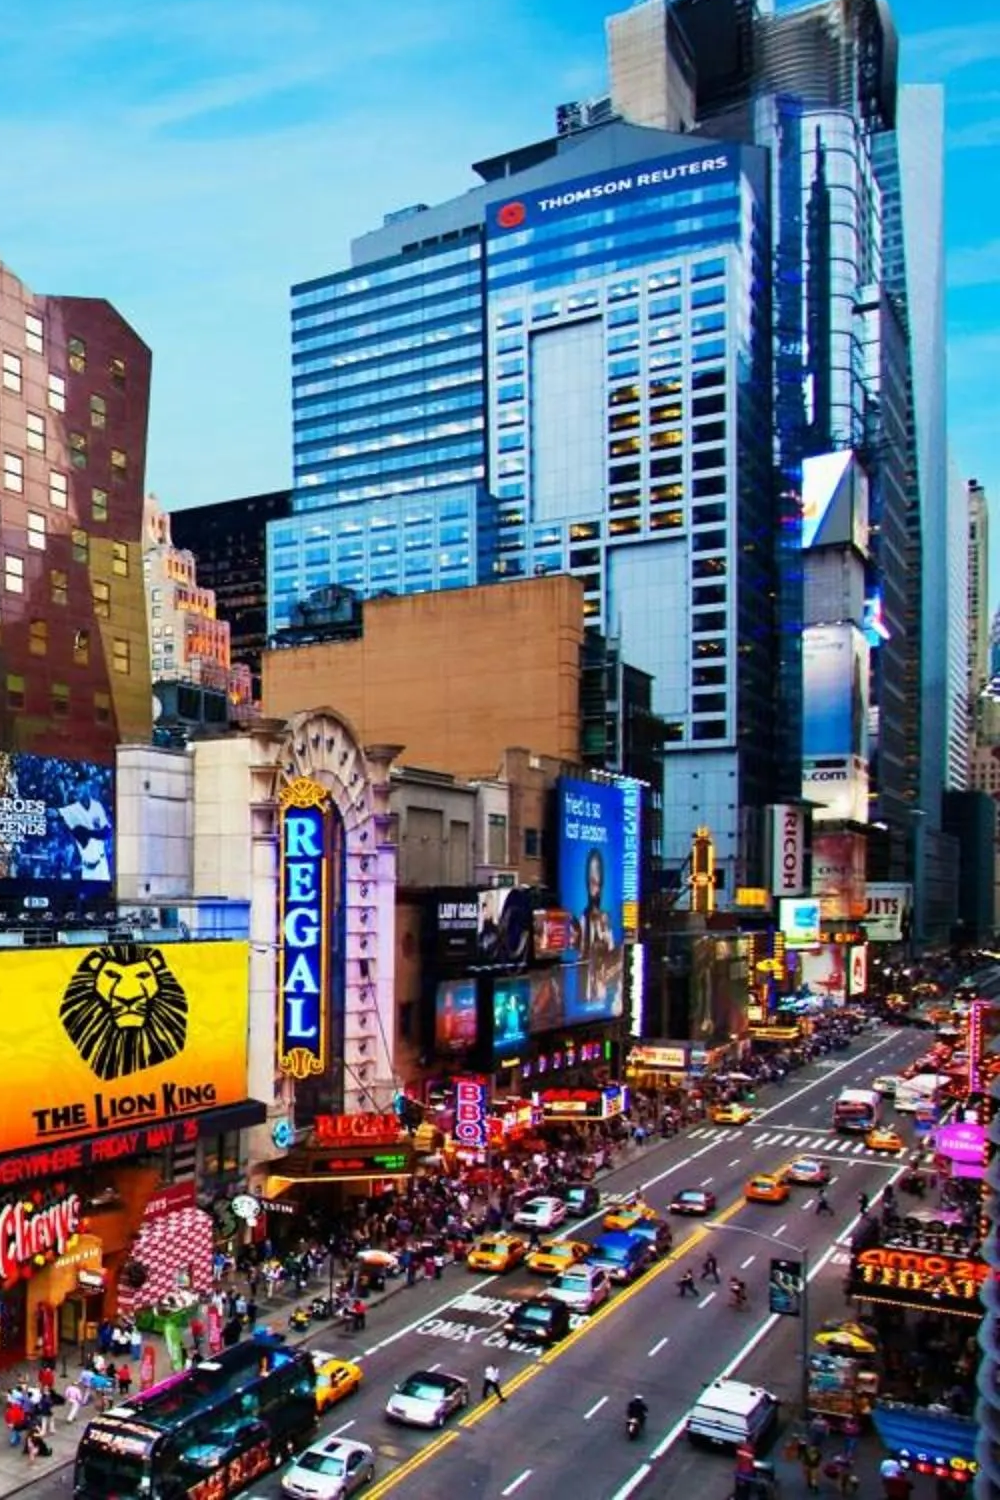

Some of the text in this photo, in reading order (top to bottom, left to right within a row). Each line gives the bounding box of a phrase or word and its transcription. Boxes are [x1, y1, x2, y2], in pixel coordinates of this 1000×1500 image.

[538, 155, 728, 211] THOMSON REUTERS
[783, 811, 797, 889] RICOH
[283, 817, 321, 1037] REGAL
[32, 1082, 216, 1132] THE LION KING
[315, 1113, 400, 1138] REGAL
[455, 1082, 482, 1141] BBQ
[91, 1134, 138, 1161] FRIDAY
[146, 1123, 175, 1148] MAY
[859, 1249, 948, 1273] amc
